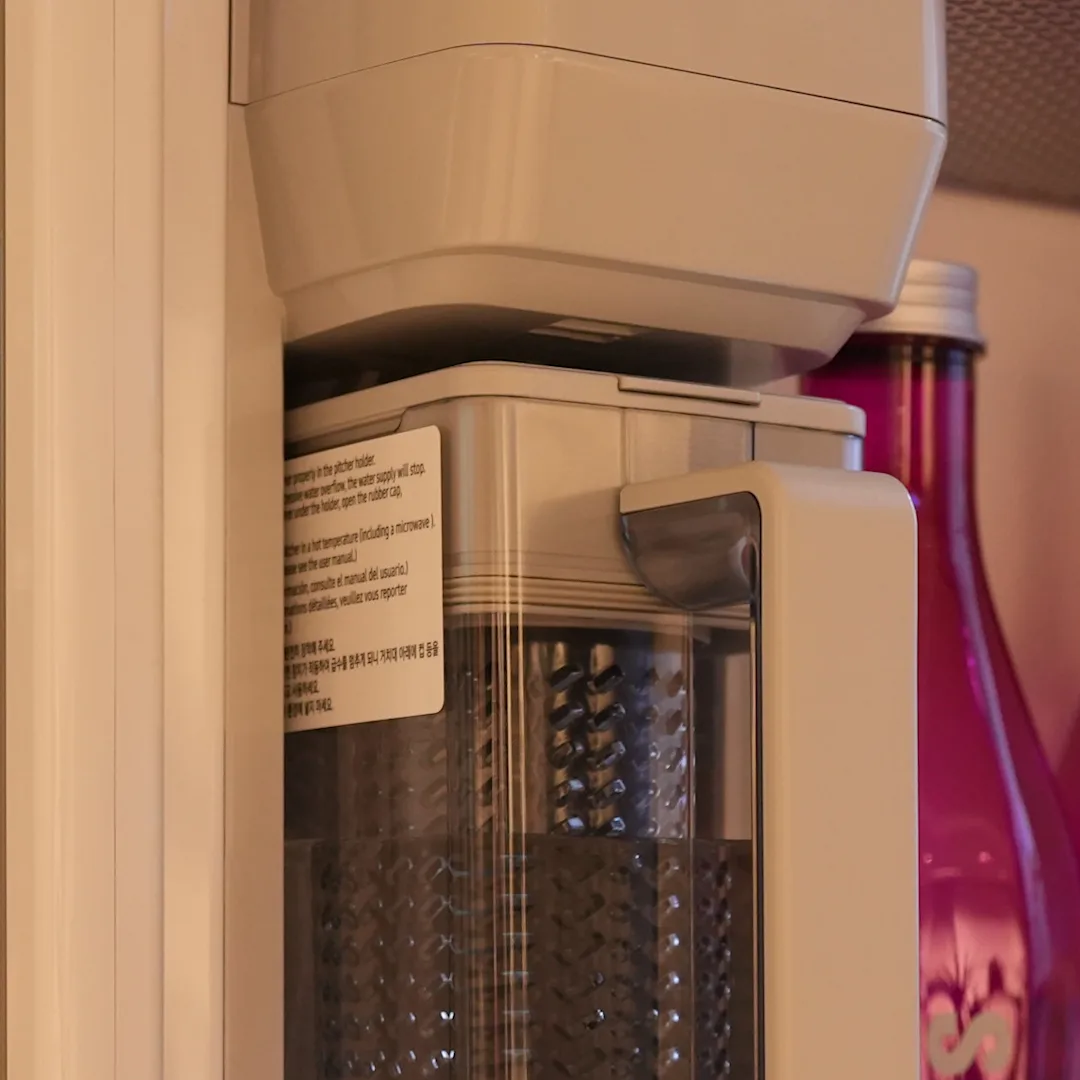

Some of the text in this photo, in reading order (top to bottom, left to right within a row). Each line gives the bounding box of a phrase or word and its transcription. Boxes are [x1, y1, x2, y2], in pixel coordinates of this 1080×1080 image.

[316, 466, 322, 478] in
[323, 464, 333, 477] the
[334, 459, 354, 477] pitcher
[355, 454, 376, 469] holder.
[347, 476, 358, 490] the
[358, 472, 375, 487] water
[376, 466, 396, 485] supply
[397, 463, 409, 478] will
[410, 462, 426, 477] stop.
[310, 501, 320, 515] the
[342, 495, 356, 510] open
[357, 491, 367, 504] the
[368, 486, 389, 501] rubber
[311, 538, 322, 552] hot
[322, 532, 358, 550] temperature
[395, 517, 430, 534] microwave
[308, 556, 318, 571] the
[319, 557, 331, 569] user
[310, 576, 336, 593] consulte
[337, 572, 343, 587] el
[344, 567, 367, 585] manual
[368, 565, 379, 581] del
[380, 560, 409, 579] usuario.)
[339, 590, 364, 606] veuillez
[364, 589, 379, 602] vous
[380, 584, 407, 602] reporter
[331, 655, 347, 673] 급수를
[367, 649, 379, 667] 되니
[380, 647, 398, 664] 거치대
[399, 644, 417, 661] 아래에
[418, 643, 425, 659] 컵
[426, 640, 439, 657] 등을
